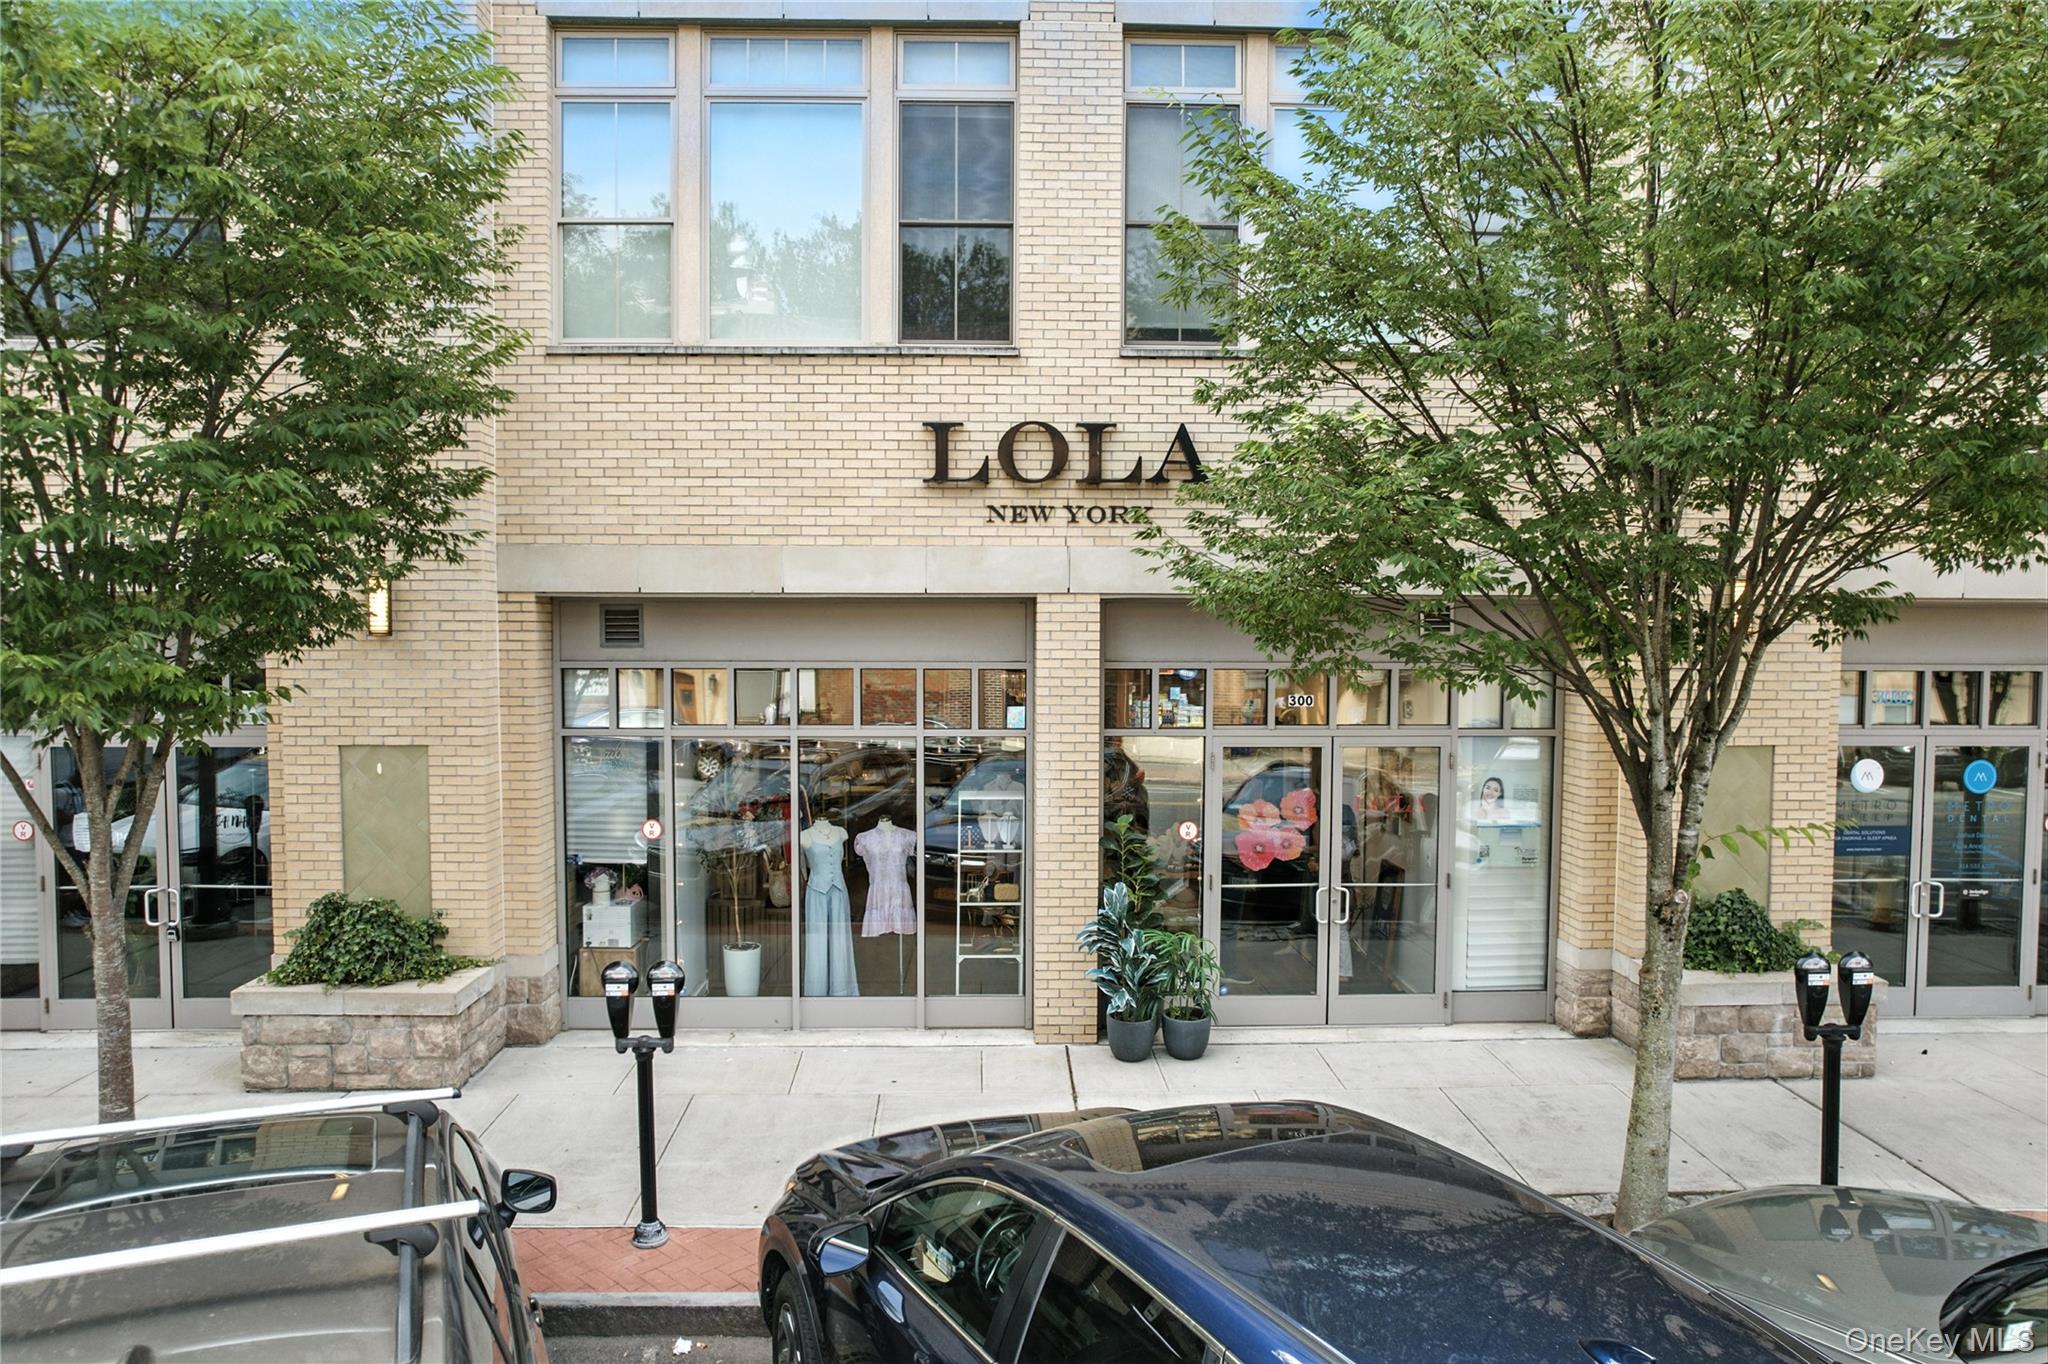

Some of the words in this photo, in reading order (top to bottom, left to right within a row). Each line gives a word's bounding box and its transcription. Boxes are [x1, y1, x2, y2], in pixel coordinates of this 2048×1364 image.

[922, 421, 1209, 484] LOLA
[986, 505, 1055, 524] NEW
[1289, 695, 1313, 706] 300
